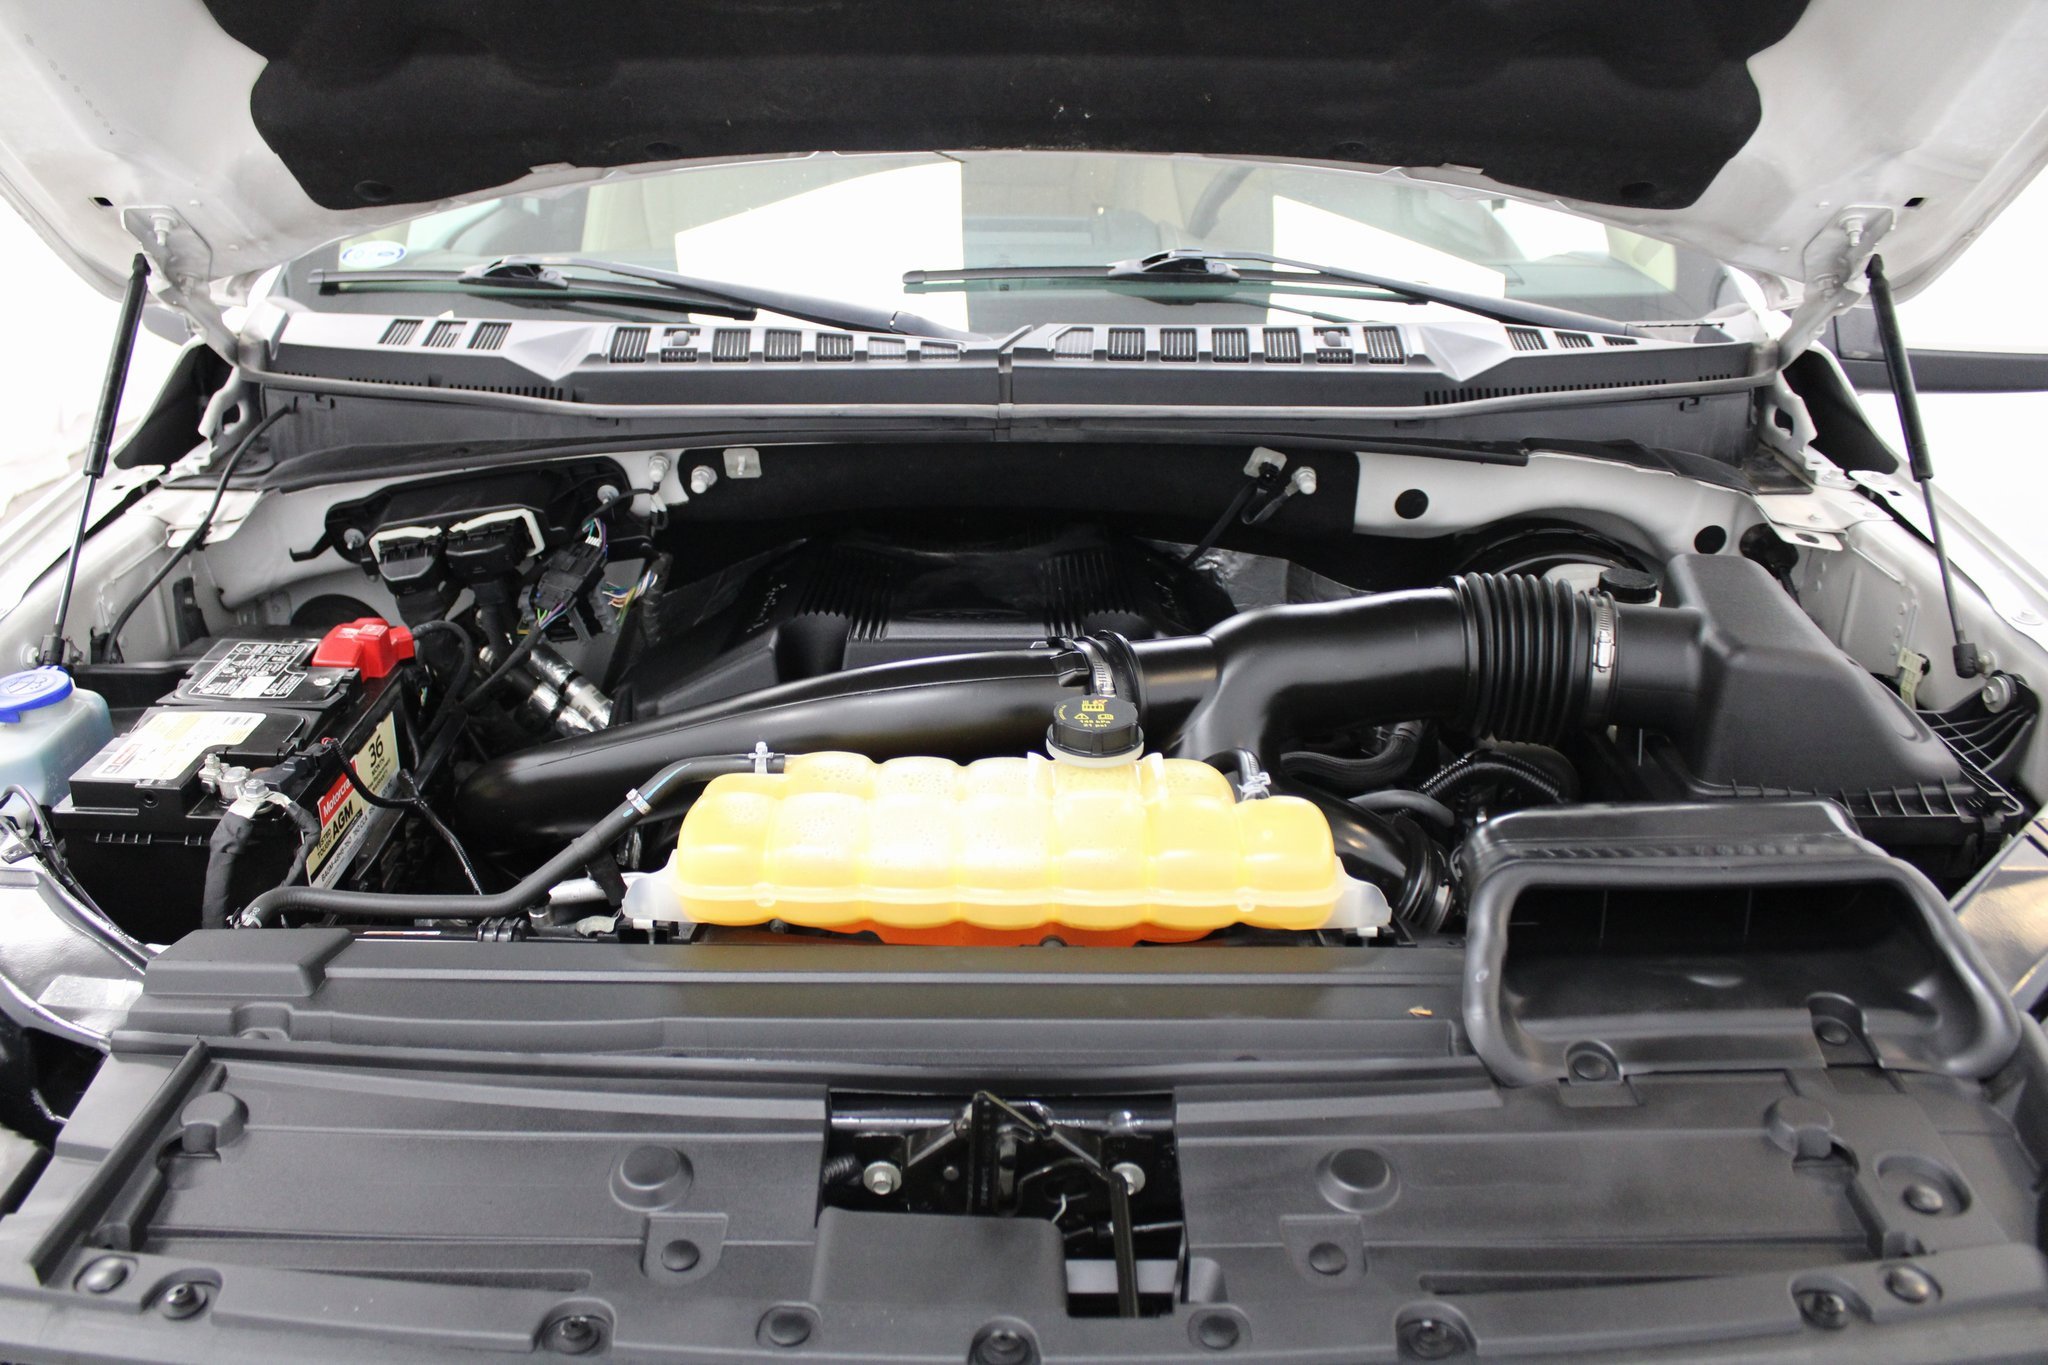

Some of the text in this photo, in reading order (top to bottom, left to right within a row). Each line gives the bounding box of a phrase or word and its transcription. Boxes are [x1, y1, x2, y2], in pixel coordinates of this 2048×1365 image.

[368, 734, 383, 768] 36
[323, 778, 352, 817] Motorcra
[332, 800, 353, 839] AGM
